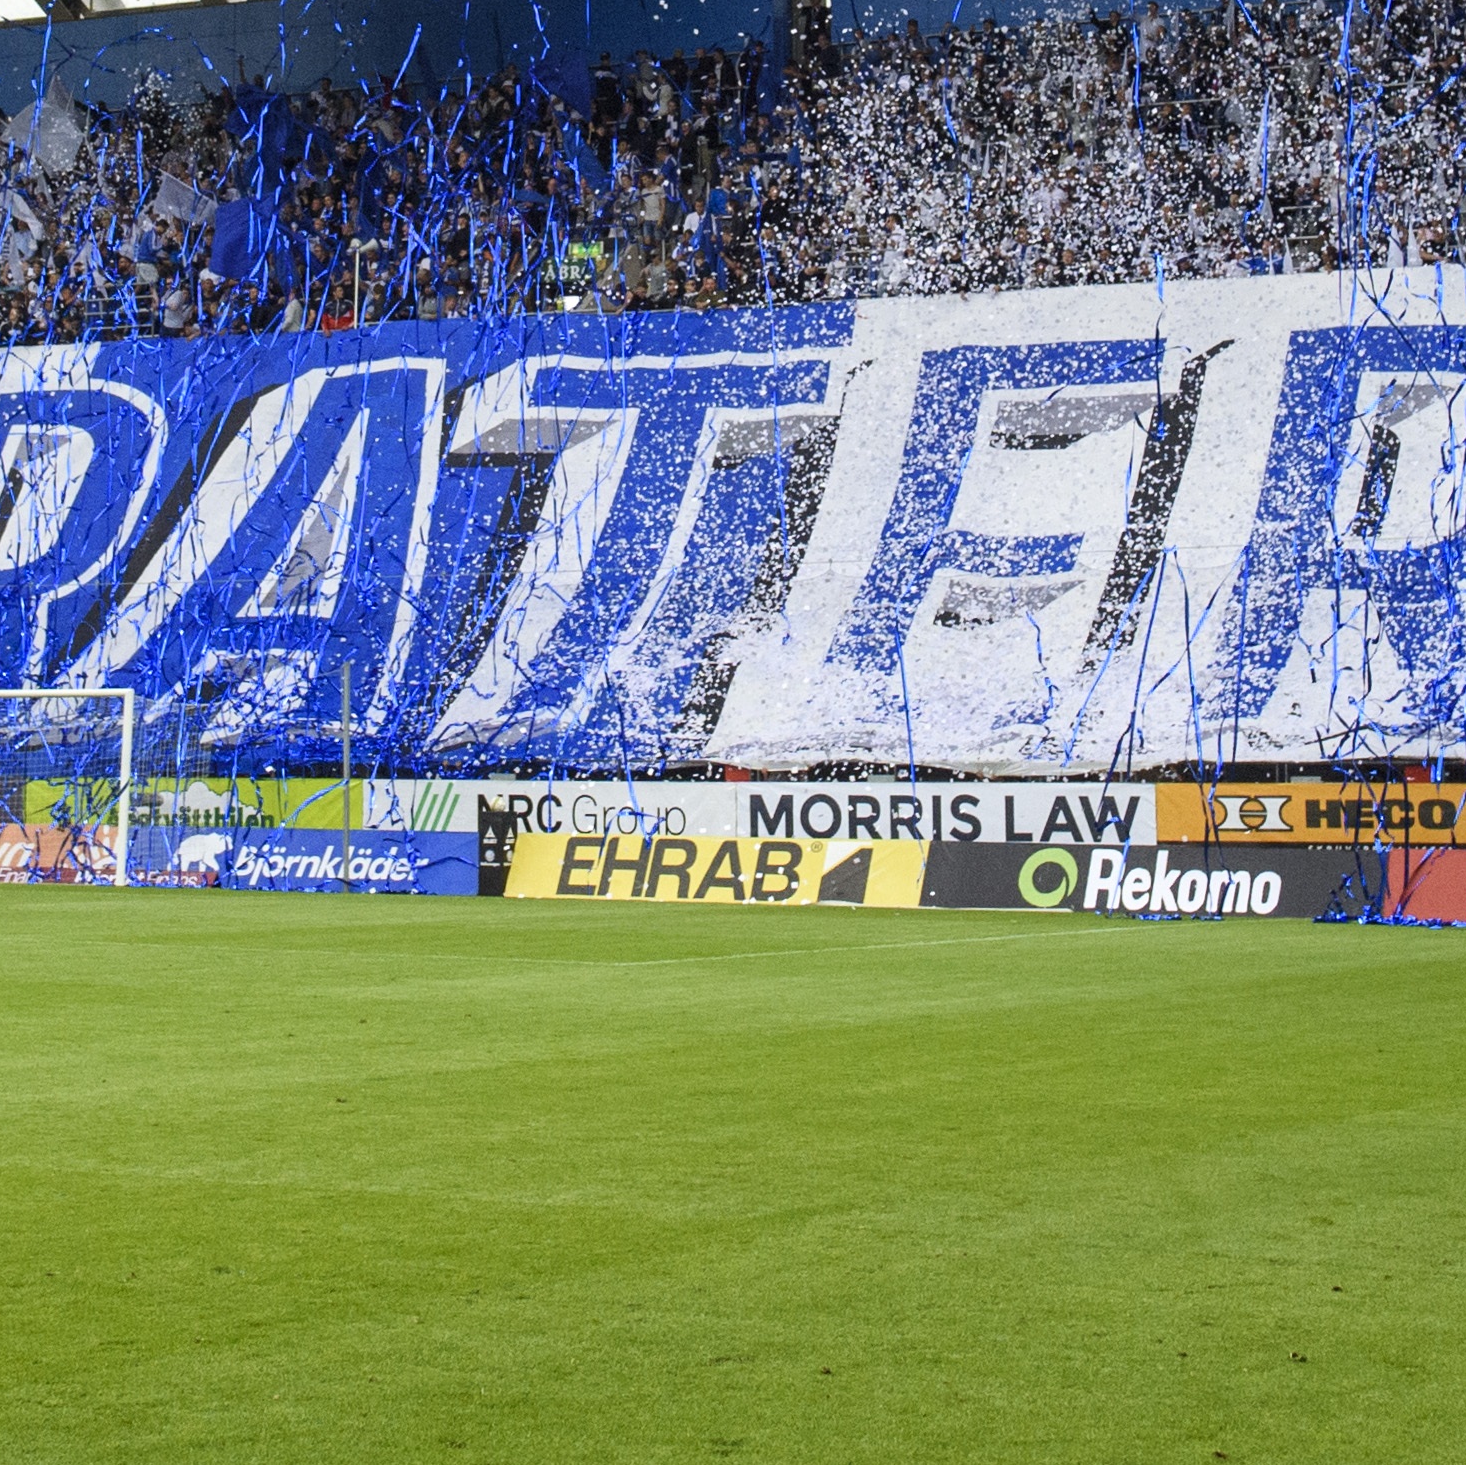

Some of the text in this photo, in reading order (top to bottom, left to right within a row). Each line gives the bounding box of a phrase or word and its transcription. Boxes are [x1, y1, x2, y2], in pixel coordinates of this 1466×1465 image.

[572, 794, 687, 835] Group
[750, 794, 1140, 842] MORRIS LAW
[1306, 798, 1457, 830] HECO
[234, 843, 429, 885] Björnkläder
[1085, 848, 1280, 914] Rekomo
